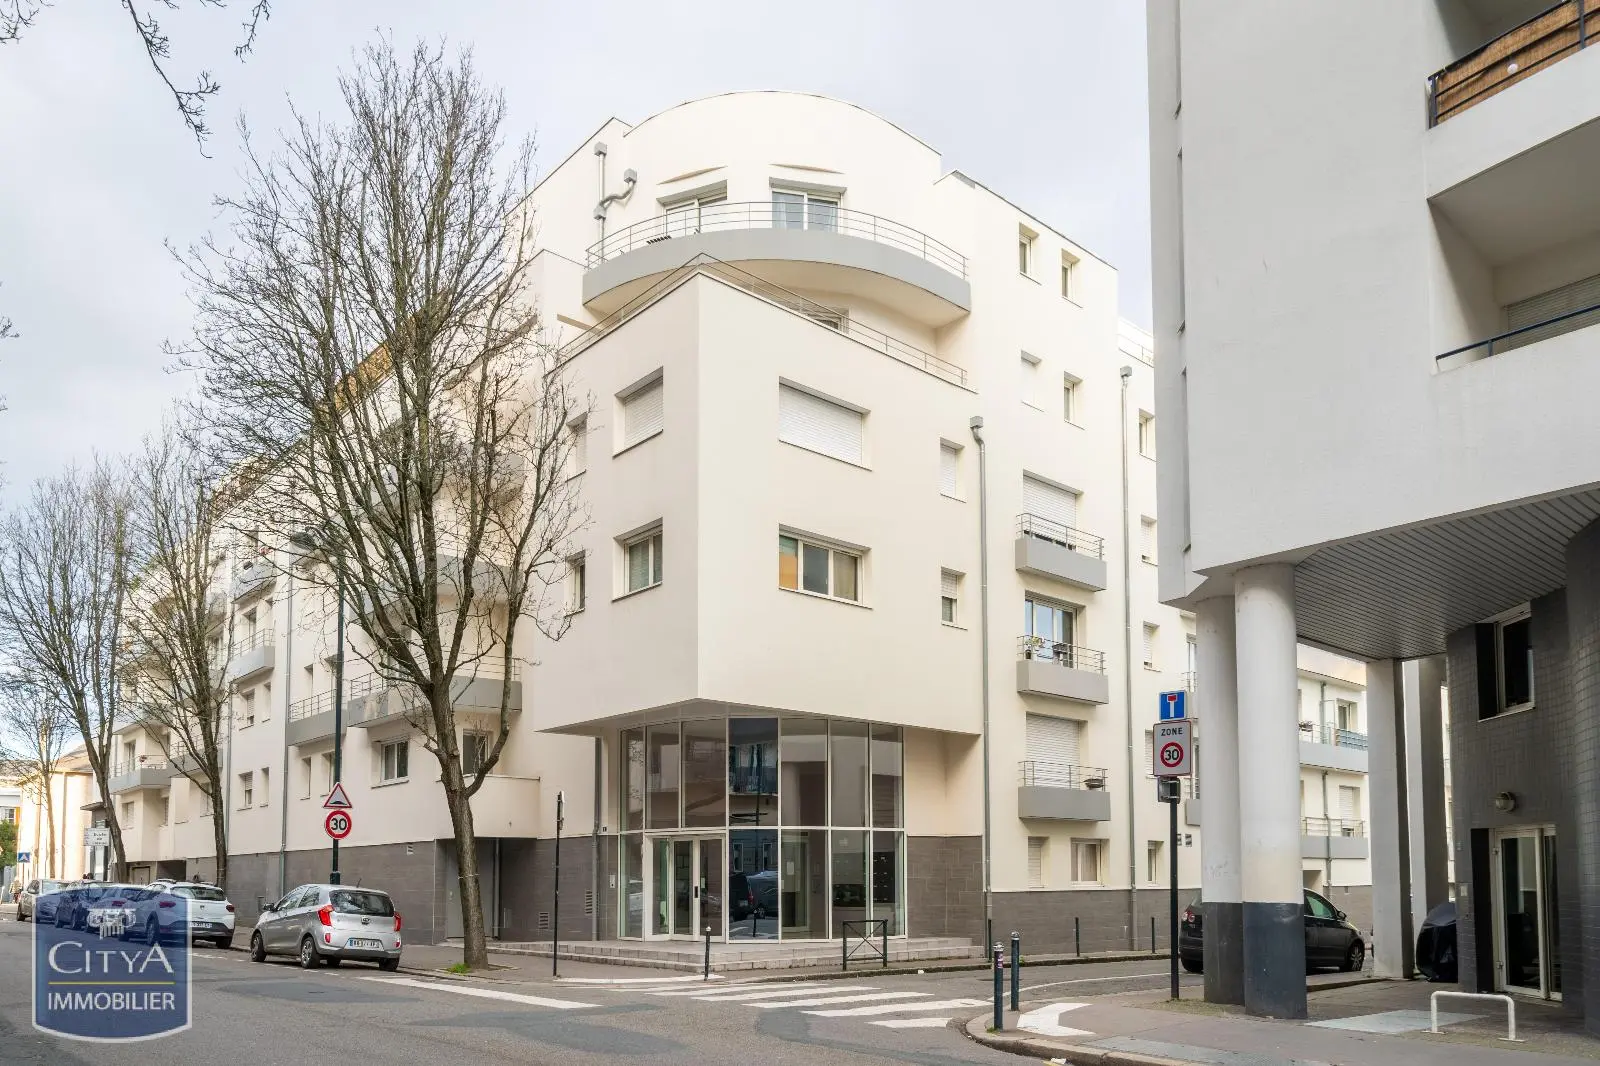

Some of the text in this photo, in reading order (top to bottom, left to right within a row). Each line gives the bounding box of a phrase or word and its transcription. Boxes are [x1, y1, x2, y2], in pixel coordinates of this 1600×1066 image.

[1161, 727, 1183, 737] ZONE
[1165, 748, 1180, 761] 30
[330, 817, 347, 831] 30
